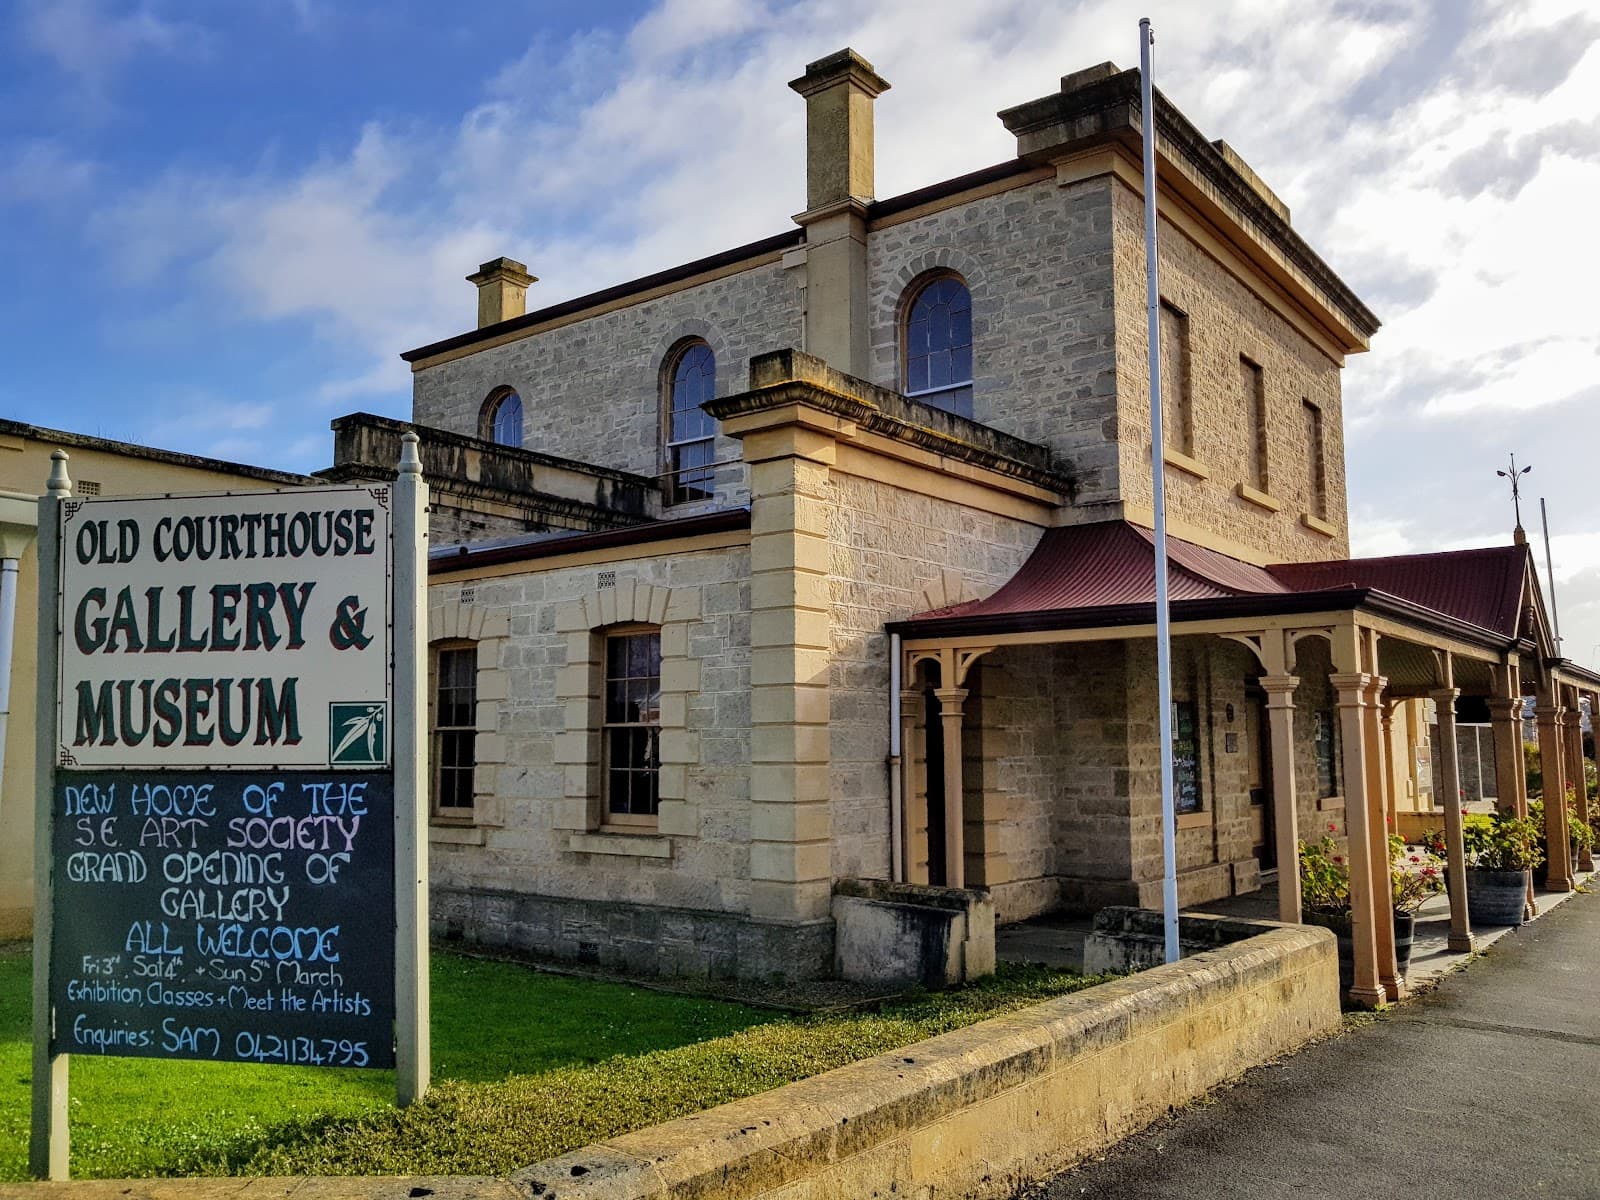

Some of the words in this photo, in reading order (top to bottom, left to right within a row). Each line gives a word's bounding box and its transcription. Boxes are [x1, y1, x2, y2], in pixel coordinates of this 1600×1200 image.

[76, 518, 140, 565] OLD
[153, 509, 375, 563] COURTHOUSE
[74, 581, 317, 656] GALLERY
[329, 595, 375, 651] &
[72, 676, 303, 748] MUSEUM
[65, 783, 115, 816] NEW
[131, 783, 217, 816] HOME
[242, 782, 285, 818] OF
[301, 782, 369, 817] THE
[139, 817, 209, 848] ART
[227, 814, 361, 851] SOCIETY
[67, 849, 147, 883] GRAND
[163, 850, 285, 885] OPENING
[305, 852, 351, 885] OF
[160, 885, 290, 922] GALLERY
[126, 920, 183, 955] ALL
[197, 924, 340, 962] WELCOME
[209, 958, 246, 982] Sun
[276, 960, 343, 987] March
[147, 981, 214, 1007] Classes
[228, 984, 275, 1011] Meet
[280, 987, 307, 1012] the
[311, 988, 371, 1016] Artists
[161, 1017, 220, 1057] SAM
[235, 1031, 369, 1067] 0421134795
